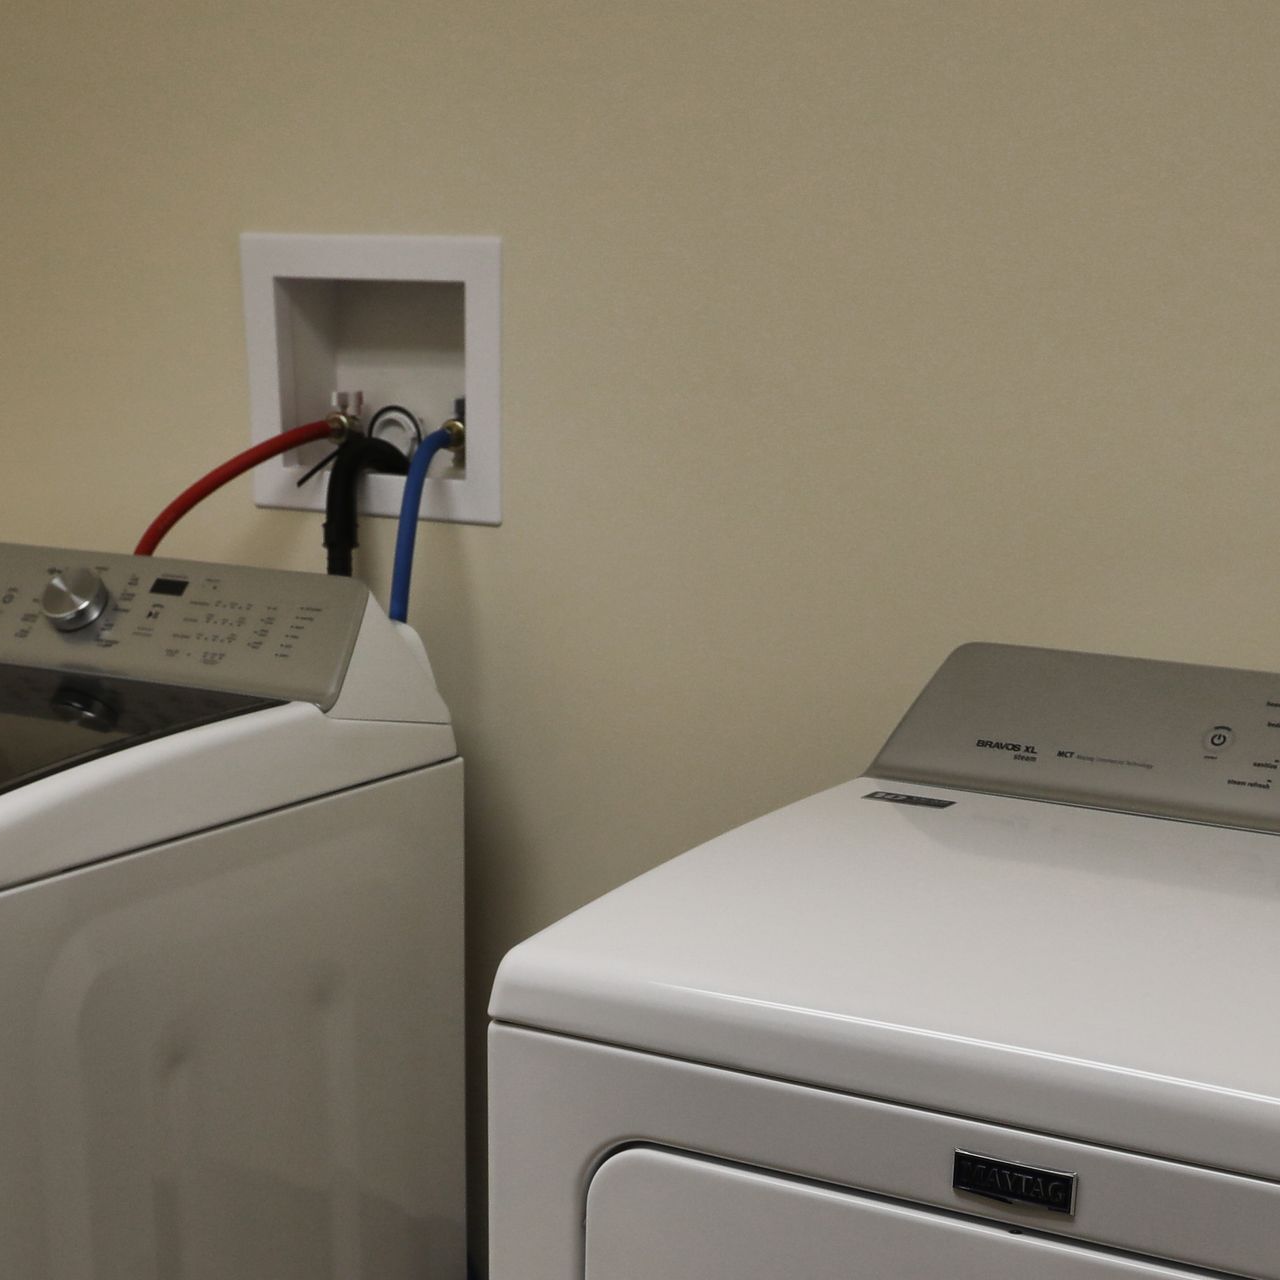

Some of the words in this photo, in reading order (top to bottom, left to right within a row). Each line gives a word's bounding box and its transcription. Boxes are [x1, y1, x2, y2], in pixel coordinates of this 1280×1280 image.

[976, 739, 1022, 752] BRAVOS
[1023, 745, 1038, 755] XL
[959, 1160, 1067, 1203] MAYTAG
